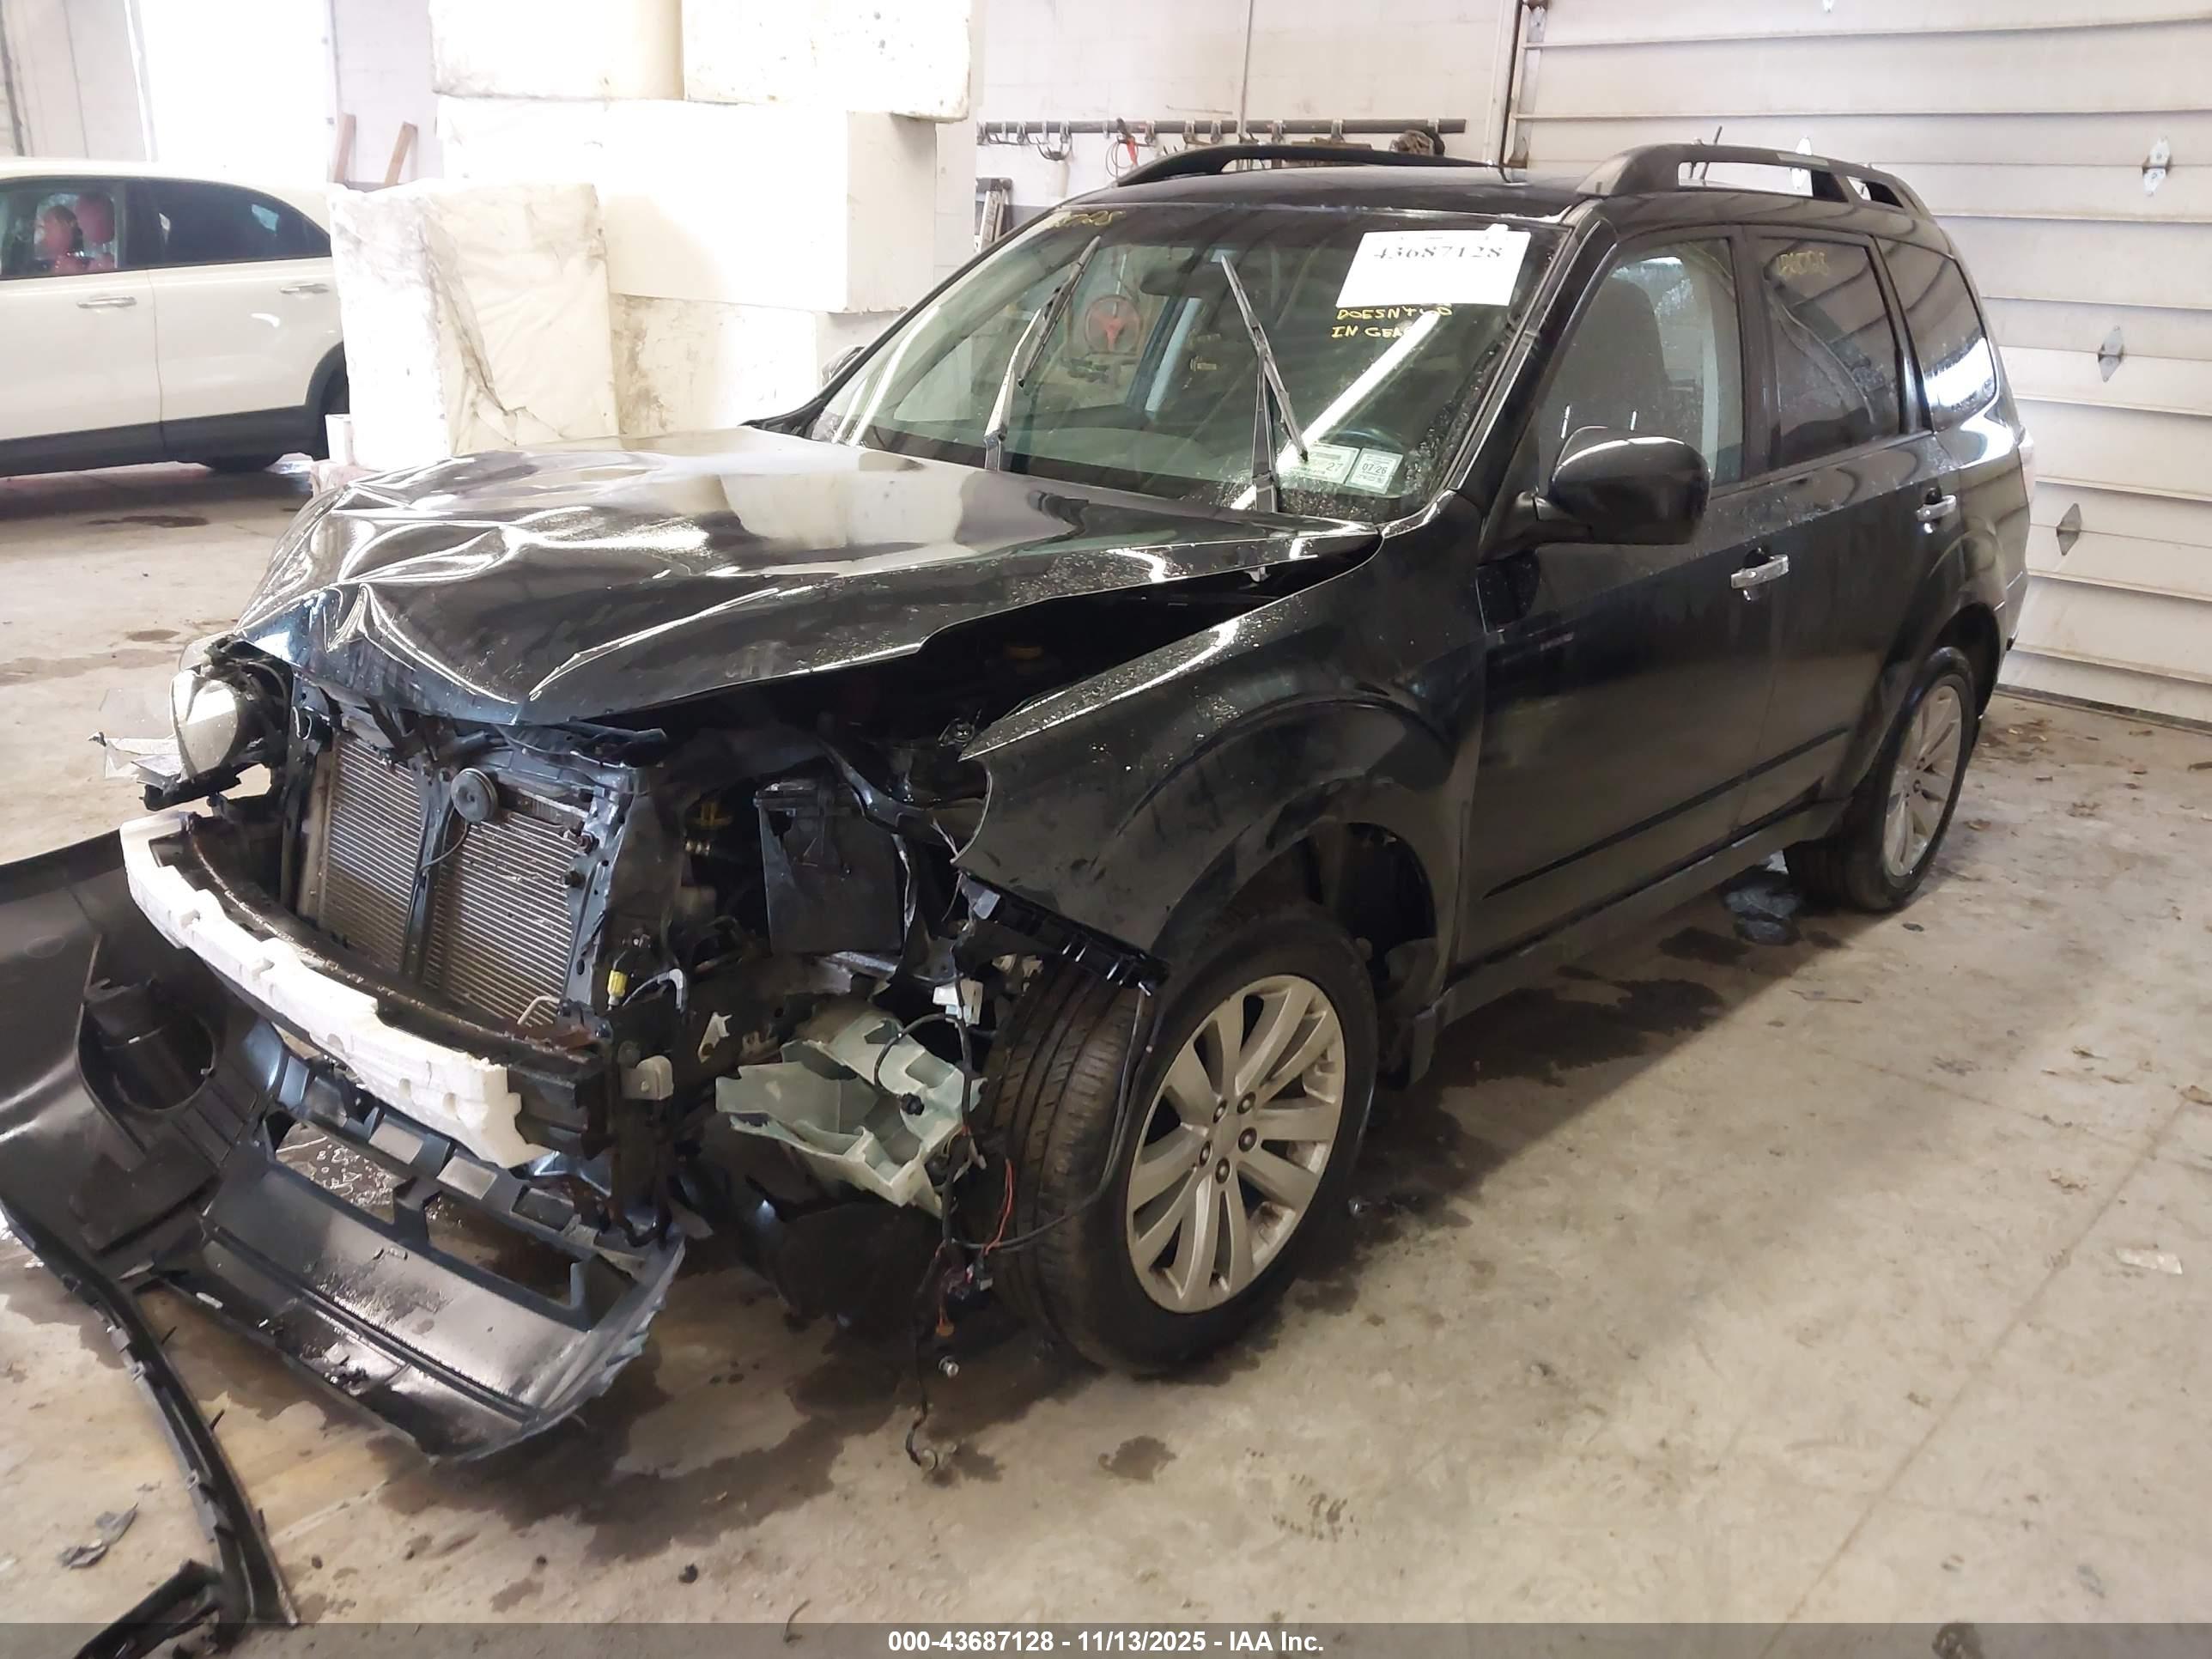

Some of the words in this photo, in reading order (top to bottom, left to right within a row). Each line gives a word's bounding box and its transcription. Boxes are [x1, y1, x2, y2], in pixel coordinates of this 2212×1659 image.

[1373, 245, 1504, 260] 43687128
[1331, 325, 1358, 338] IN
[1364, 326, 1407, 338] GEA
